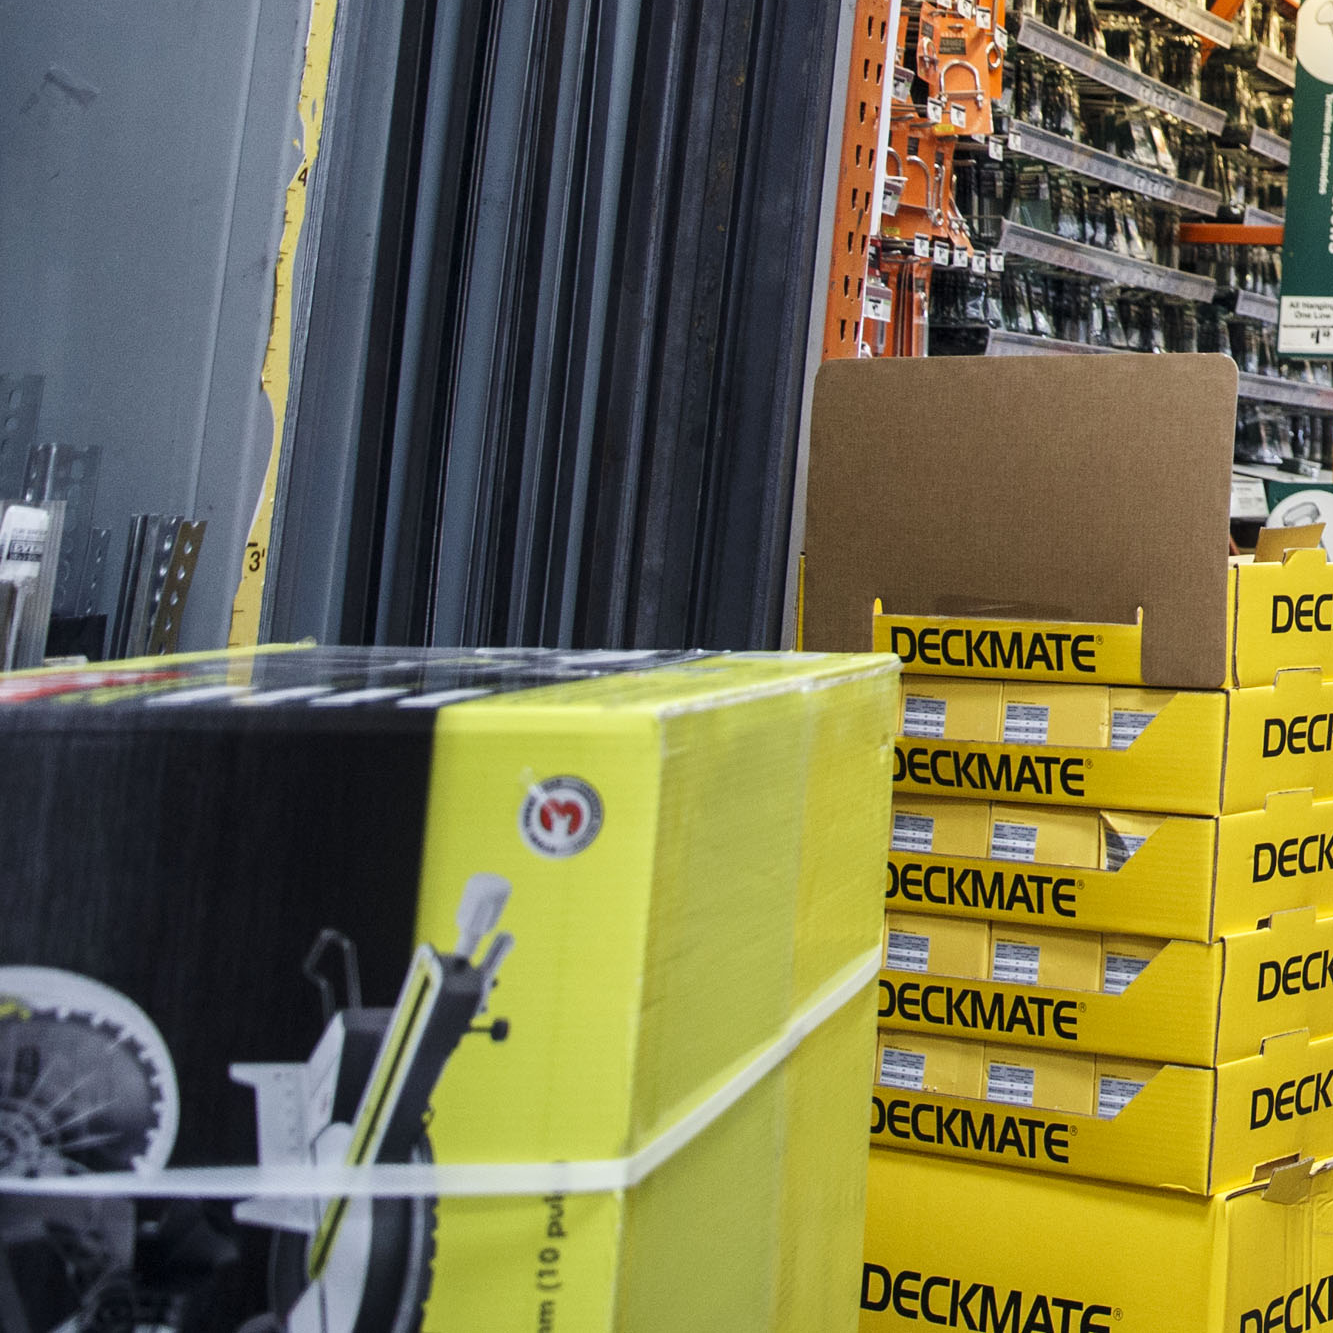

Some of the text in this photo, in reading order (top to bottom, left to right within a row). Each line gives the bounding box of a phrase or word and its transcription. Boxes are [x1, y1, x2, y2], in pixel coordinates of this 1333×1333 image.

[891, 626, 1096, 673] DECKMATE
[894, 747, 1085, 798] DECKMATE
[885, 860, 1077, 918] DECKMATE
[876, 979, 1078, 1041] DECKMATE
[869, 1094, 1069, 1164] DECKMATE
[860, 1261, 1113, 1333] DECKMATE
